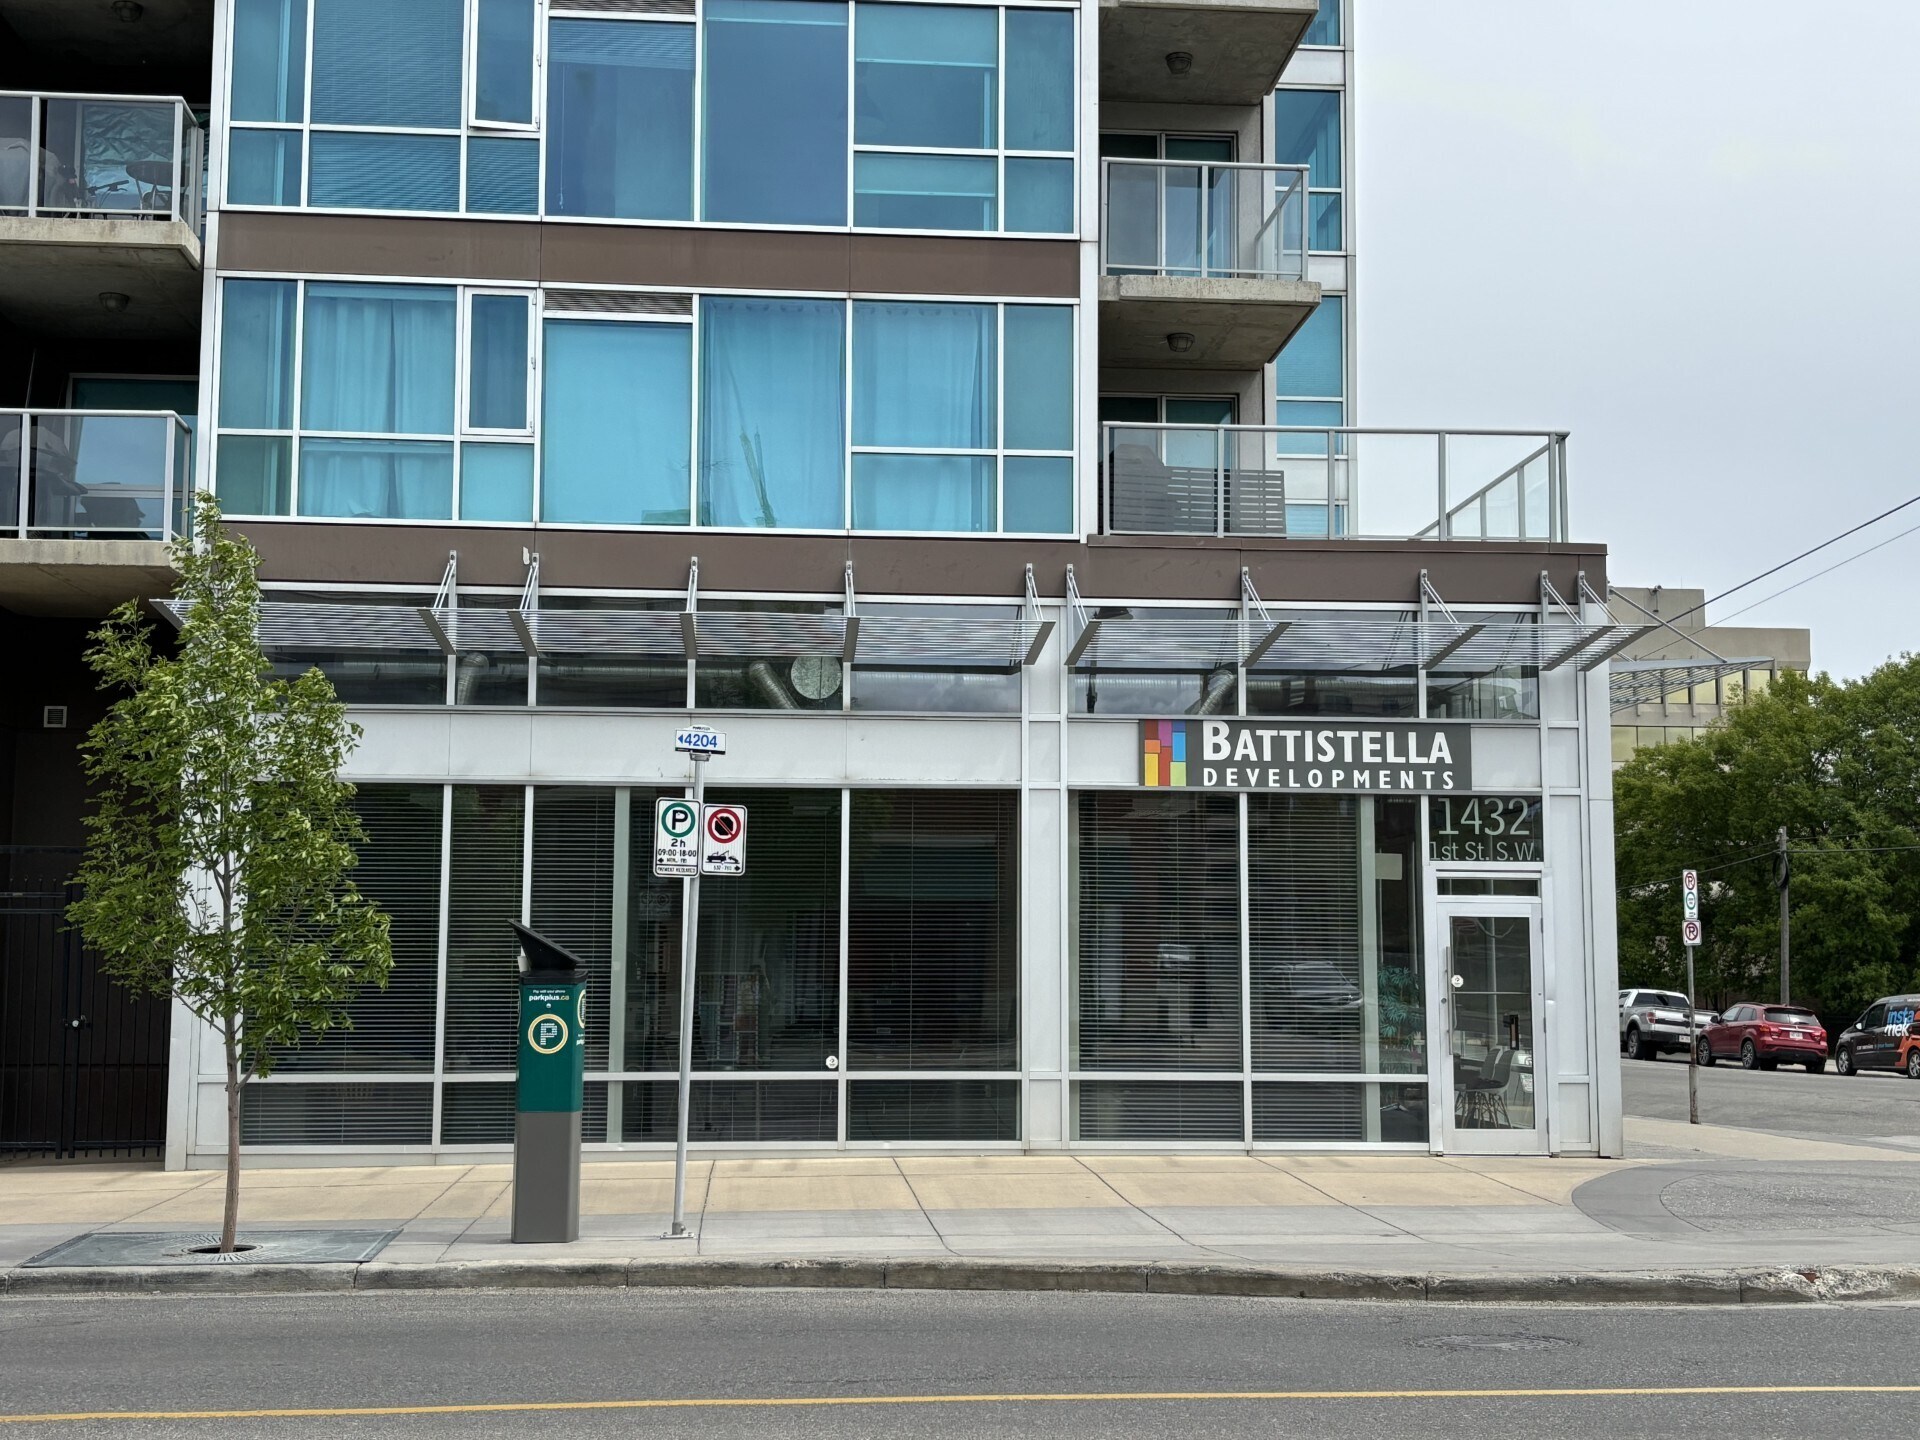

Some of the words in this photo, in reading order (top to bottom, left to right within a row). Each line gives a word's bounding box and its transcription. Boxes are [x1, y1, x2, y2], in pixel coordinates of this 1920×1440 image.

[684, 733, 717, 748] 4204
[1202, 720, 1453, 764] BATTISTELLA
[1203, 768, 1454, 790] DEVELOPMENTS
[671, 809, 689, 830] P
[1437, 797, 1530, 835] 1432
[1429, 841, 1459, 860] 1st
[1465, 841, 1490, 861] St.
[1496, 841, 1540, 861] S.W.
[1887, 1006, 1915, 1024] insta
[1884, 1018, 1911, 1037] mek
